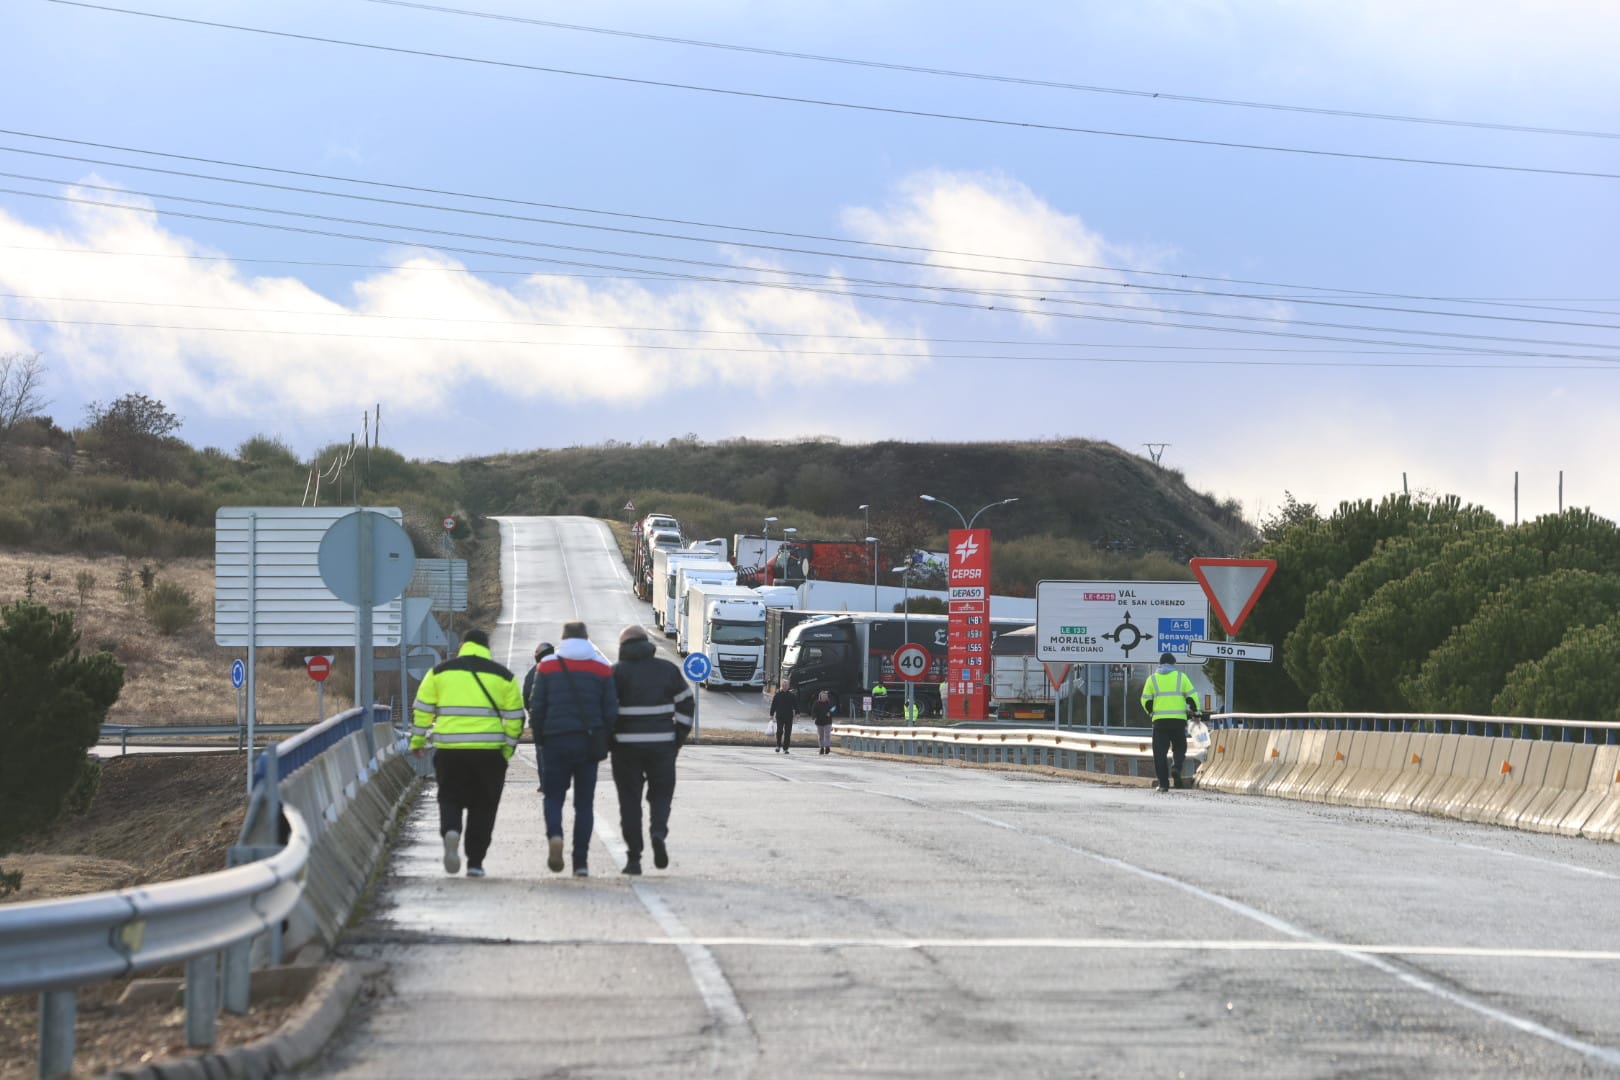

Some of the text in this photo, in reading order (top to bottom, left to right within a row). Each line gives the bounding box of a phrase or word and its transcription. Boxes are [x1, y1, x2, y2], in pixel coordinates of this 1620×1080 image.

[952, 568, 982, 579] CEPSA
[952, 589, 982, 598] DEPASO
[1118, 589, 1137, 598] VAL
[1173, 621, 1190, 629] A-6
[1050, 636, 1097, 644] MORALES
[1159, 632, 1203, 640] Benavente
[1060, 645, 1105, 653] ARCEDIANO
[1216, 646, 1234, 655] 150
[901, 655, 924, 669] 40
